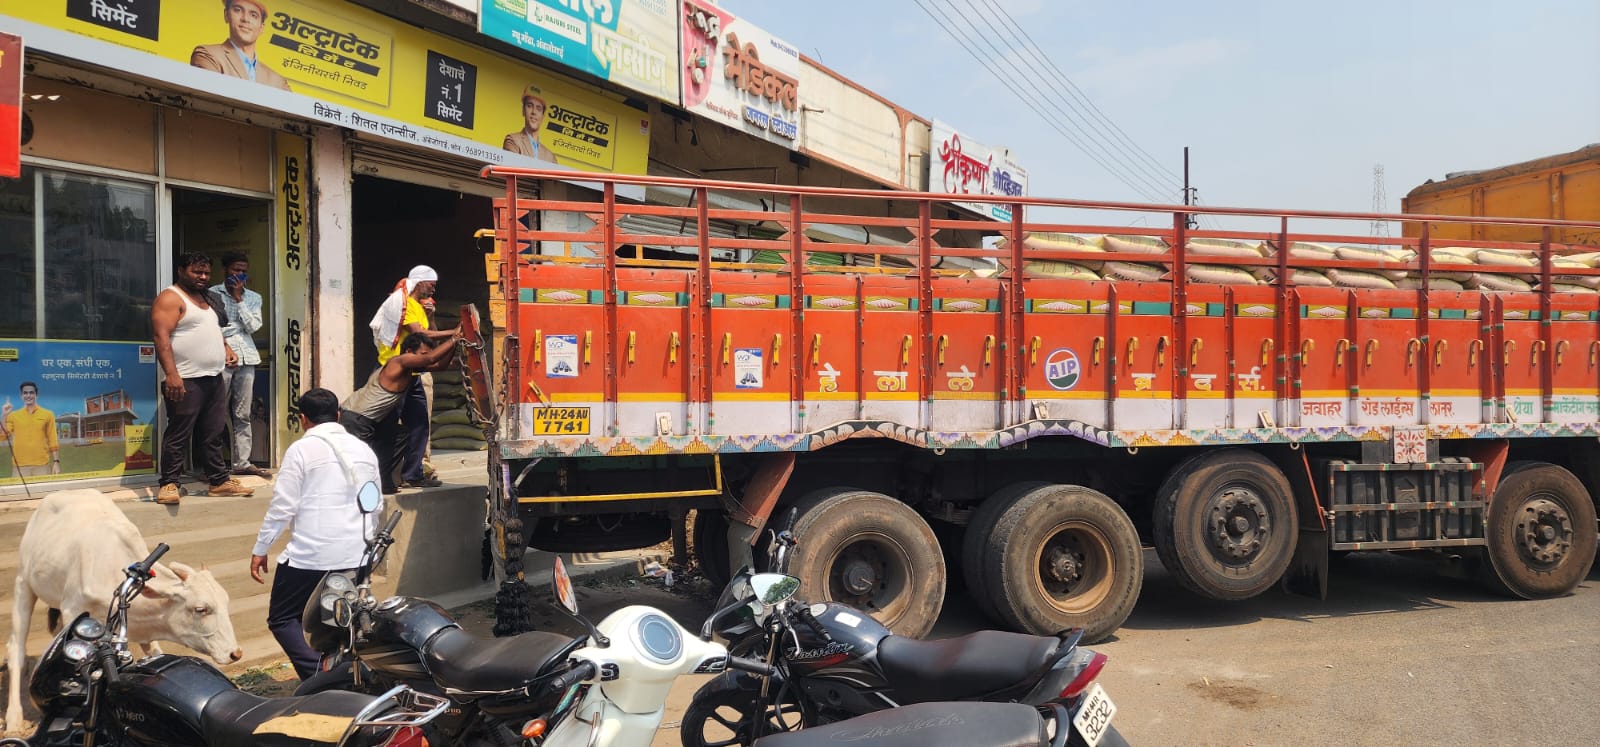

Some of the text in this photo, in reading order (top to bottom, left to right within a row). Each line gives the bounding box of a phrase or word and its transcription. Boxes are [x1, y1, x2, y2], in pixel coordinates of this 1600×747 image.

[90, 0, 138, 28] सिमेंट
[271, 12, 380, 60] अल्ट्राटेक
[566, 24, 582, 36] STEEL
[438, 58, 466, 82] देशाचे
[723, 31, 799, 112] मेडिकल
[454, 83, 462, 103] 1
[437, 100, 463, 122] सिमेंट
[547, 104, 610, 136] अल्ट्राटेक
[352, 114, 378, 132] शितल
[283, 155, 302, 271] अल्ट्राटेक
[1049, 360, 1077, 378] AIP
[1302, 401, 1343, 418] जवाहर
[542, 421, 583, 433] 7741
[1085, 699, 1113, 741] 3232
